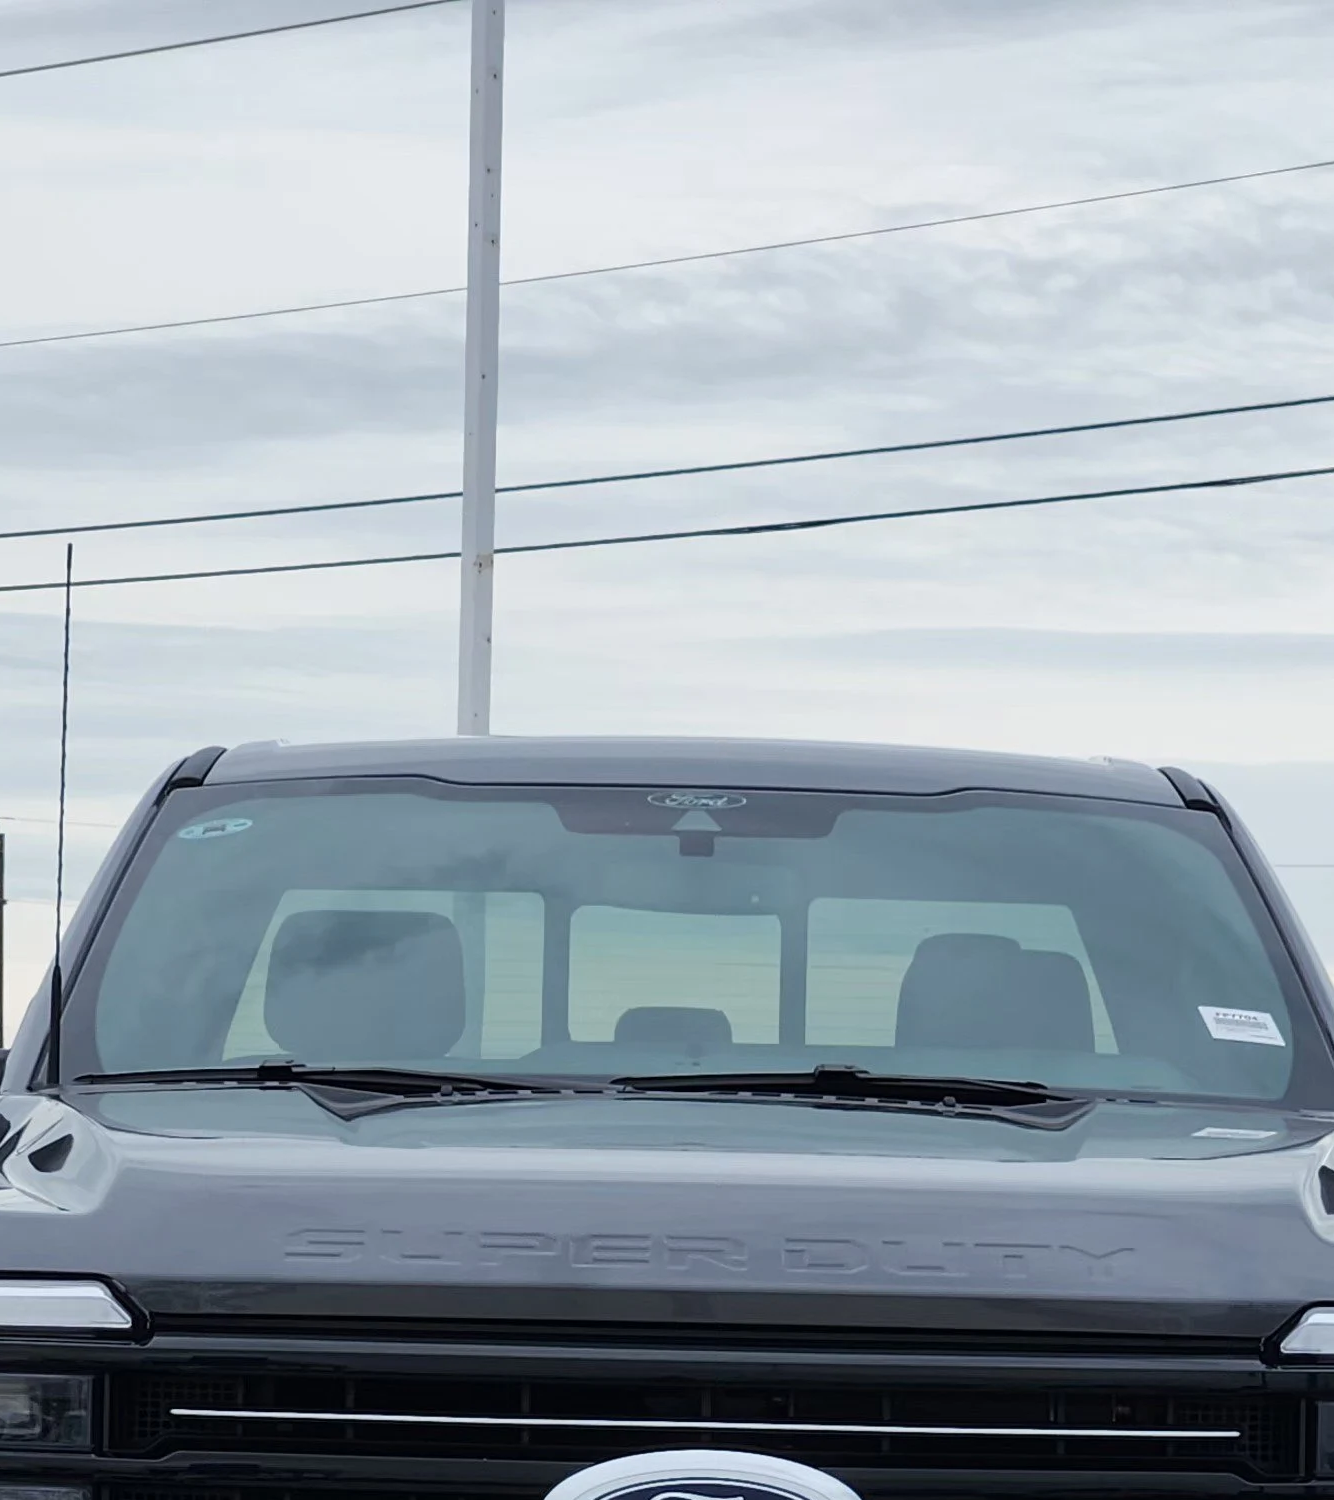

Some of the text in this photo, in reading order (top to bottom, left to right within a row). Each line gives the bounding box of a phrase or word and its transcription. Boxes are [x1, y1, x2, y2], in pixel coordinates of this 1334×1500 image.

[665, 793, 728, 806] Ford
[284, 1228, 1135, 1279] SUPER DUTY
